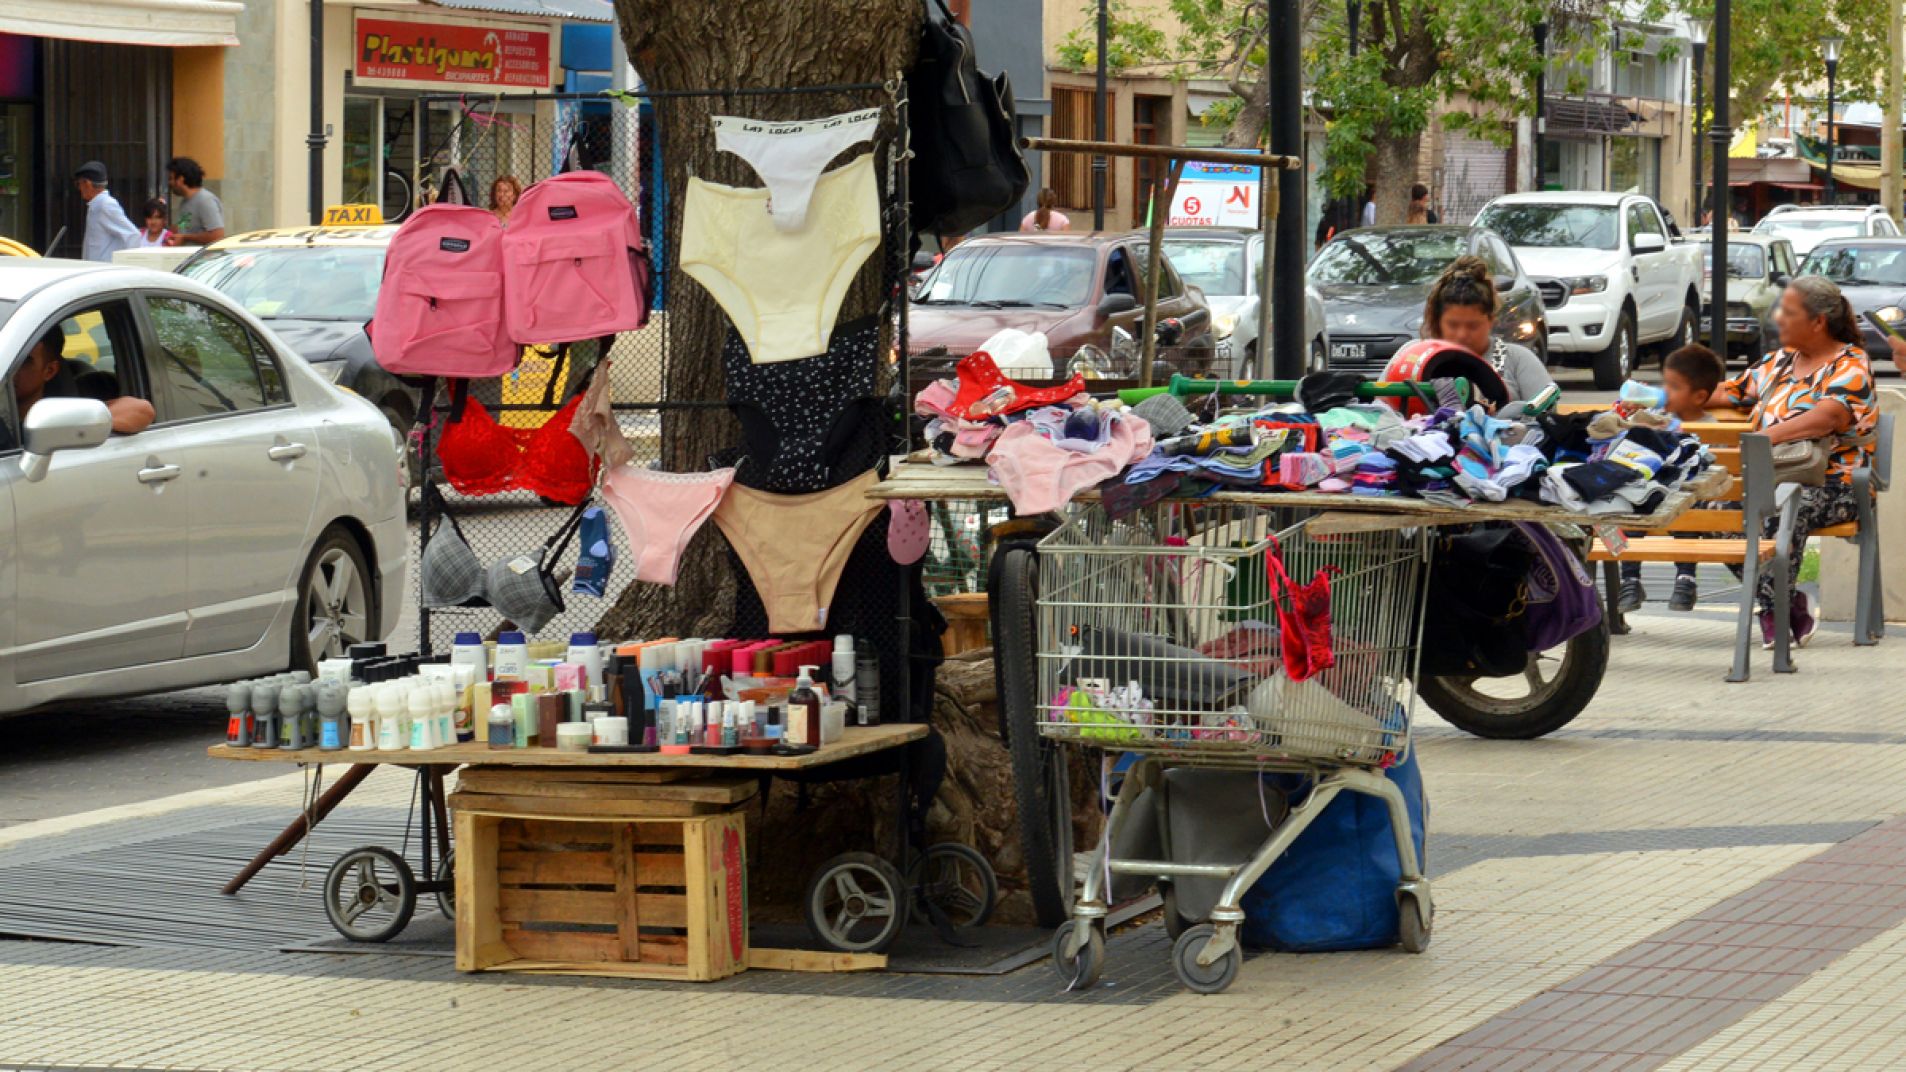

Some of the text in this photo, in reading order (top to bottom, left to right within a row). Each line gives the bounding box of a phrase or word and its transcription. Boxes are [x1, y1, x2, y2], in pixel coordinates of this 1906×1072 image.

[362, 33, 494, 76] Plastigoma
[743, 124, 803, 135] LAS LOCAS
[823, 120, 842, 129] LAS
[1185, 198, 1198, 213] 5
[328, 208, 371, 223] TAXI
[1171, 217, 1212, 226] CUOTAS
